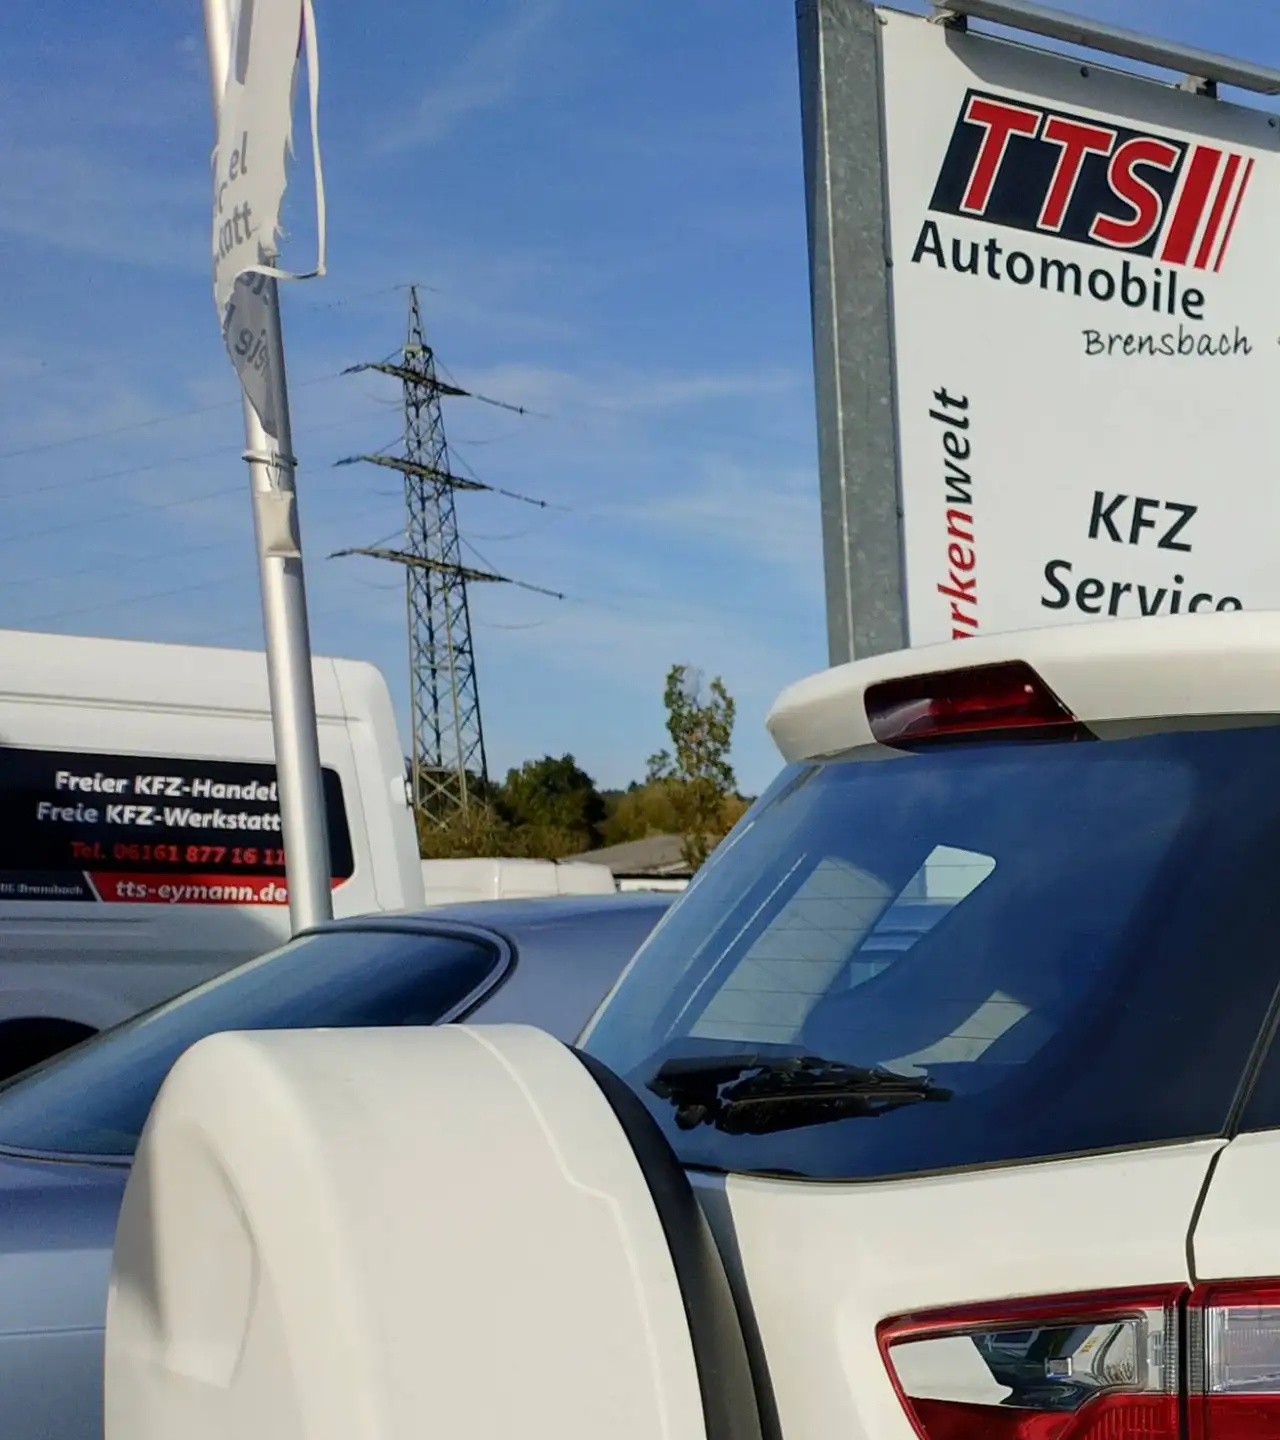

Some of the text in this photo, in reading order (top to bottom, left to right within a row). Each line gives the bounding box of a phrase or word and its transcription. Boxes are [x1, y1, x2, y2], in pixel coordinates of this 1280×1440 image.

[959, 95, 1182, 249] TTS
[910, 218, 1206, 321] Automobile
[1082, 323, 1253, 357] Brensbach
[1087, 490, 1199, 553] KFZ
[54, 770, 278, 802] Freier KFZ-Handel
[36, 801, 282, 832] Freie KFZ-Werkstatt
[71, 841, 106, 860] Tel.
[185, 845, 228, 863] 877
[231, 847, 258, 865] 16
[115, 880, 288, 903] tts-eymann.de
